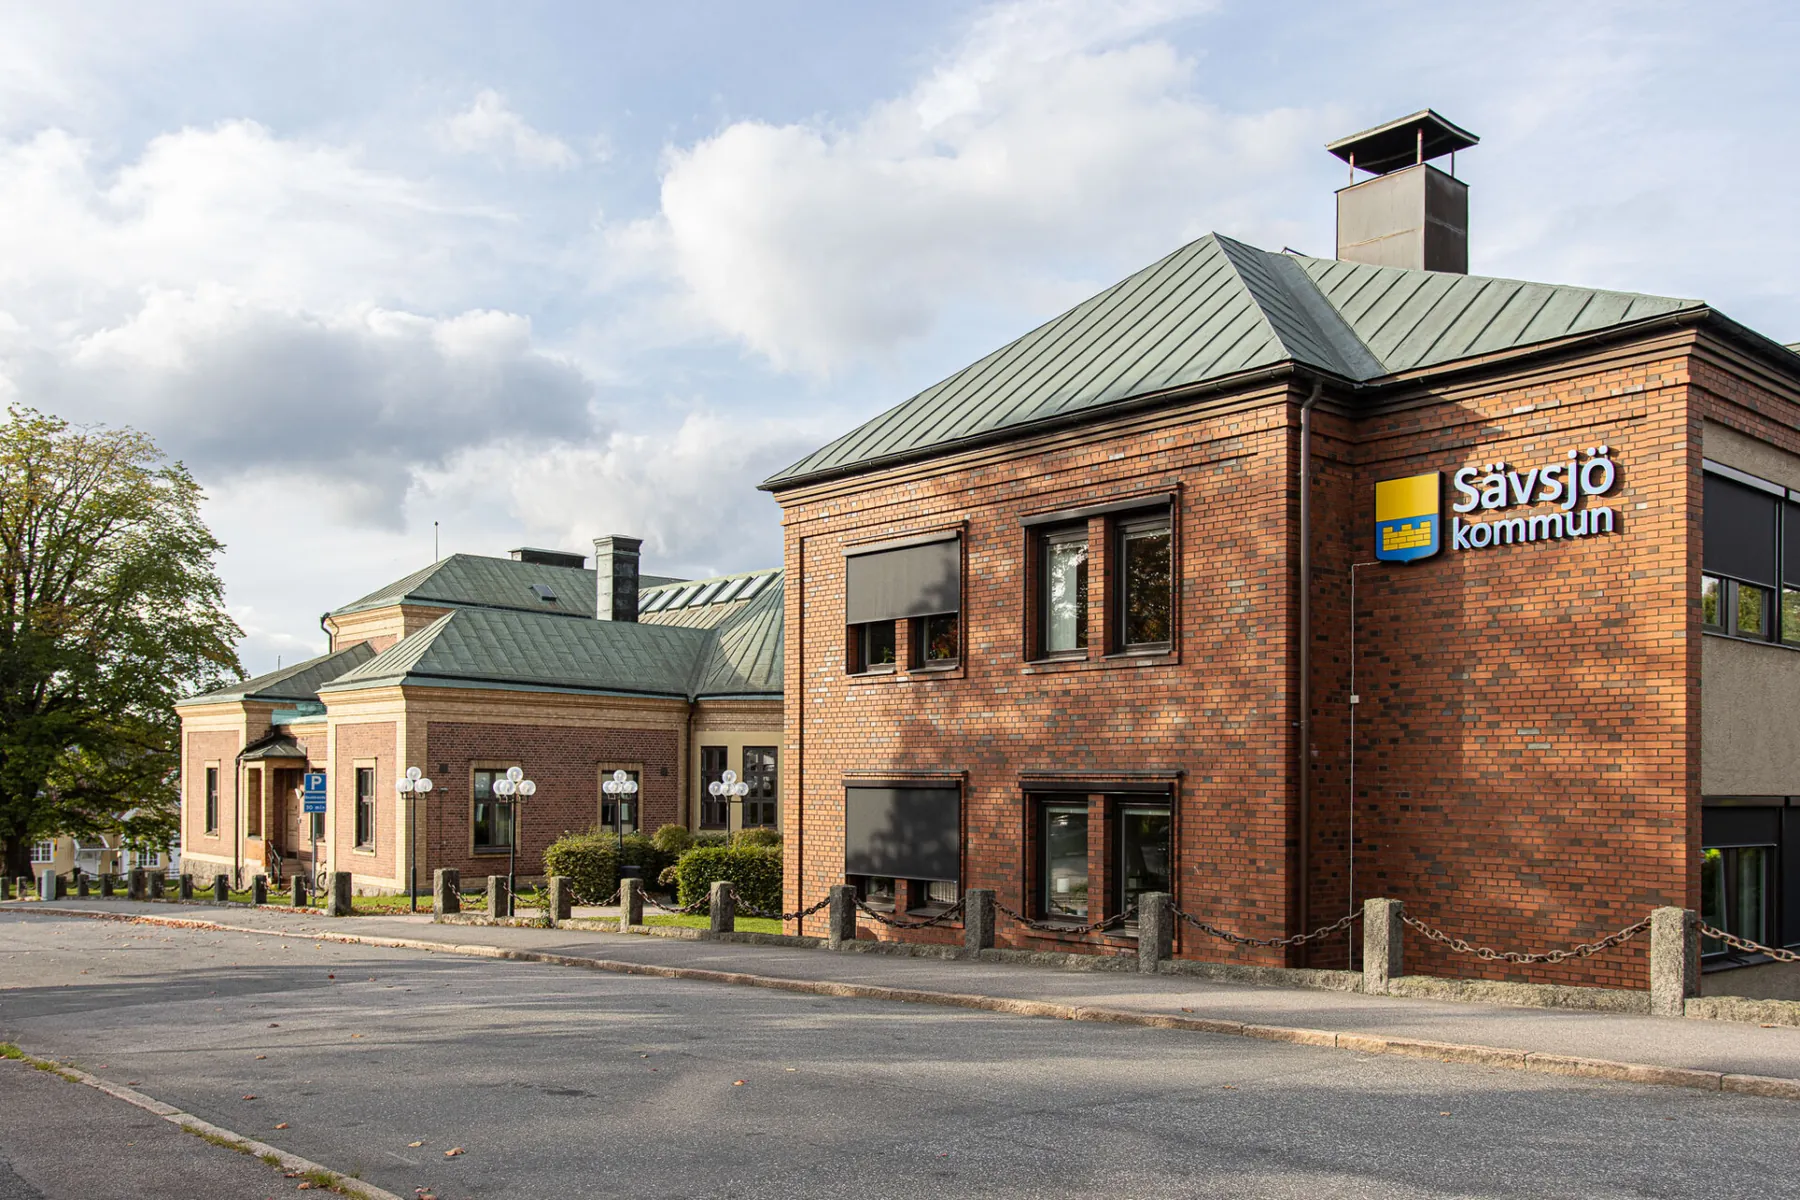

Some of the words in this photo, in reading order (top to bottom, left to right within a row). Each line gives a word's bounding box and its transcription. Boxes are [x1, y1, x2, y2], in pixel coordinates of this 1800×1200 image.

[1452, 445, 1615, 513] Sävsjö
[1452, 506, 1614, 550] kommun
[311, 775, 322, 790] P
